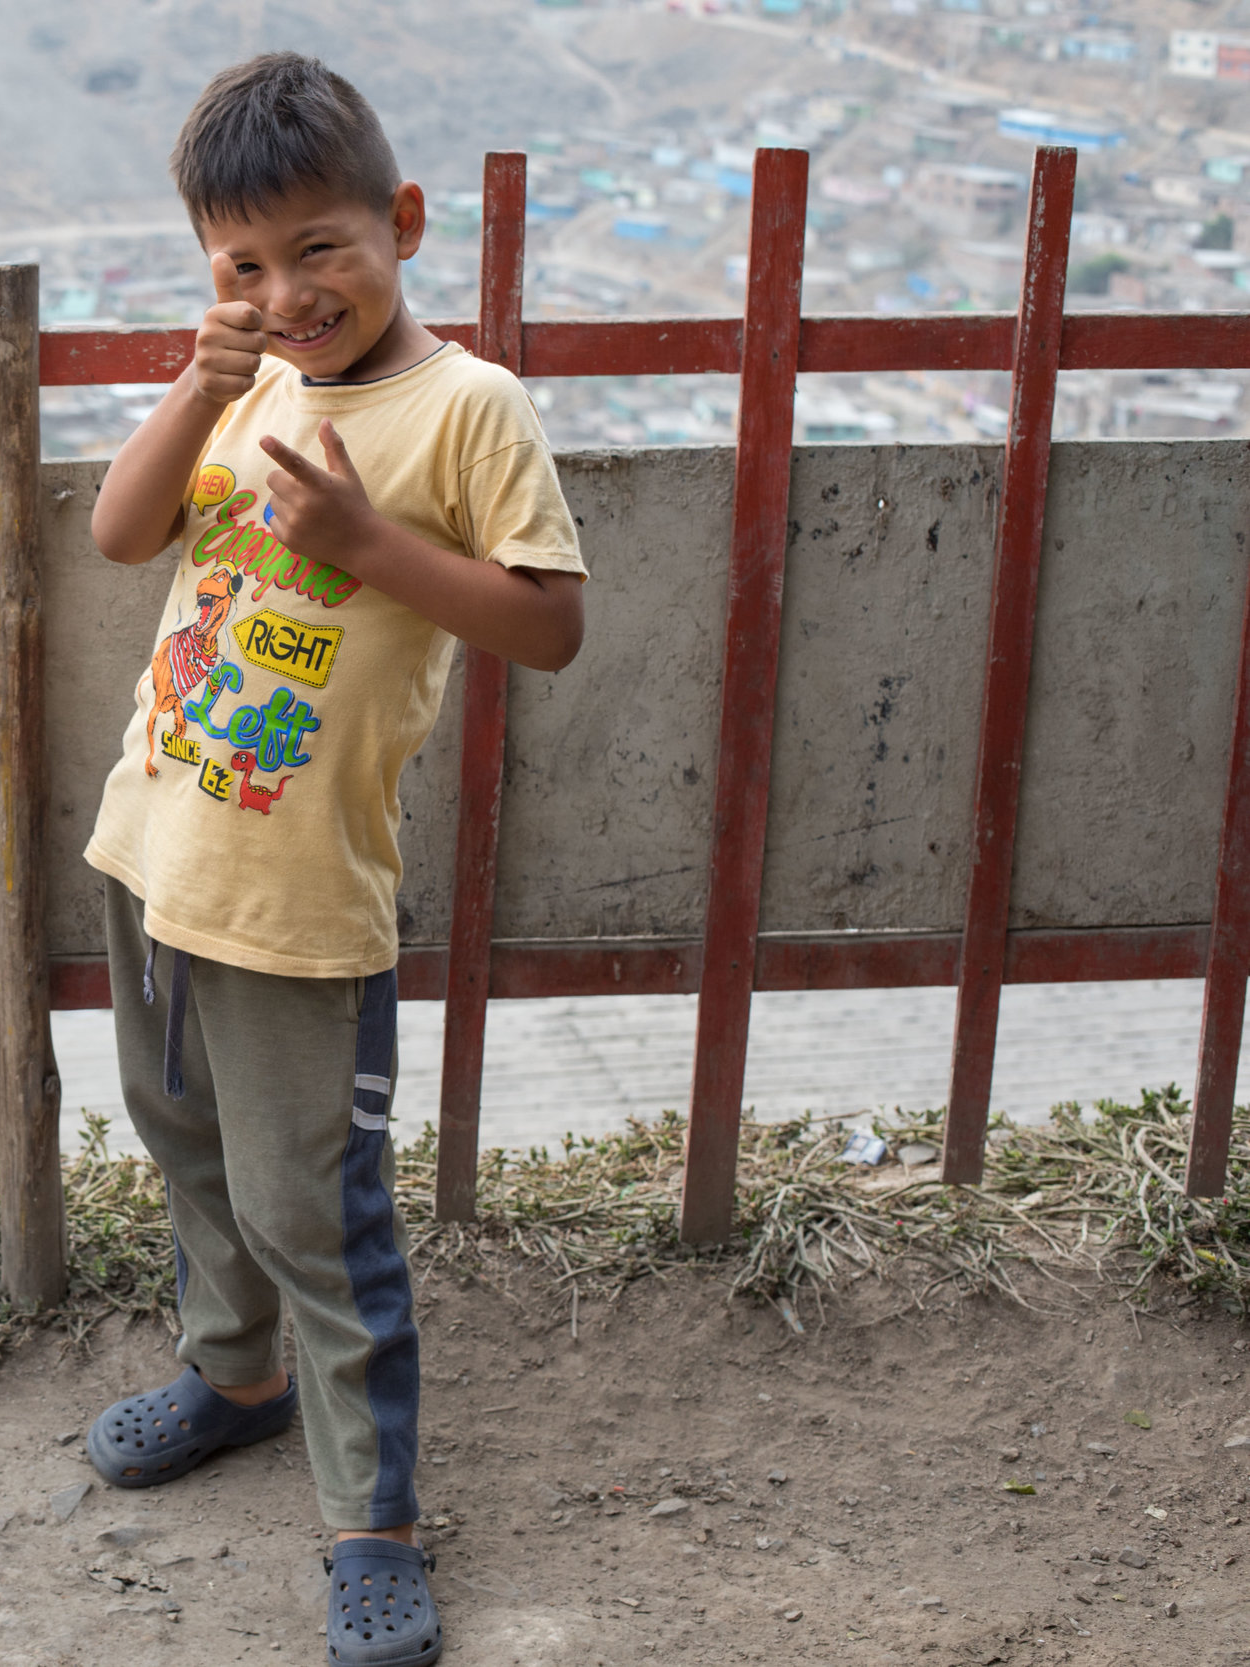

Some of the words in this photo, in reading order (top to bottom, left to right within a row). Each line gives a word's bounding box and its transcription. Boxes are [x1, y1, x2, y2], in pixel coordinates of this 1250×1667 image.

[192, 489, 362, 608] Everyone
[246, 619, 332, 671] RIGHT
[184, 662, 320, 772] Left
[161, 731, 202, 766] SINCE
[198, 757, 235, 802] 63
